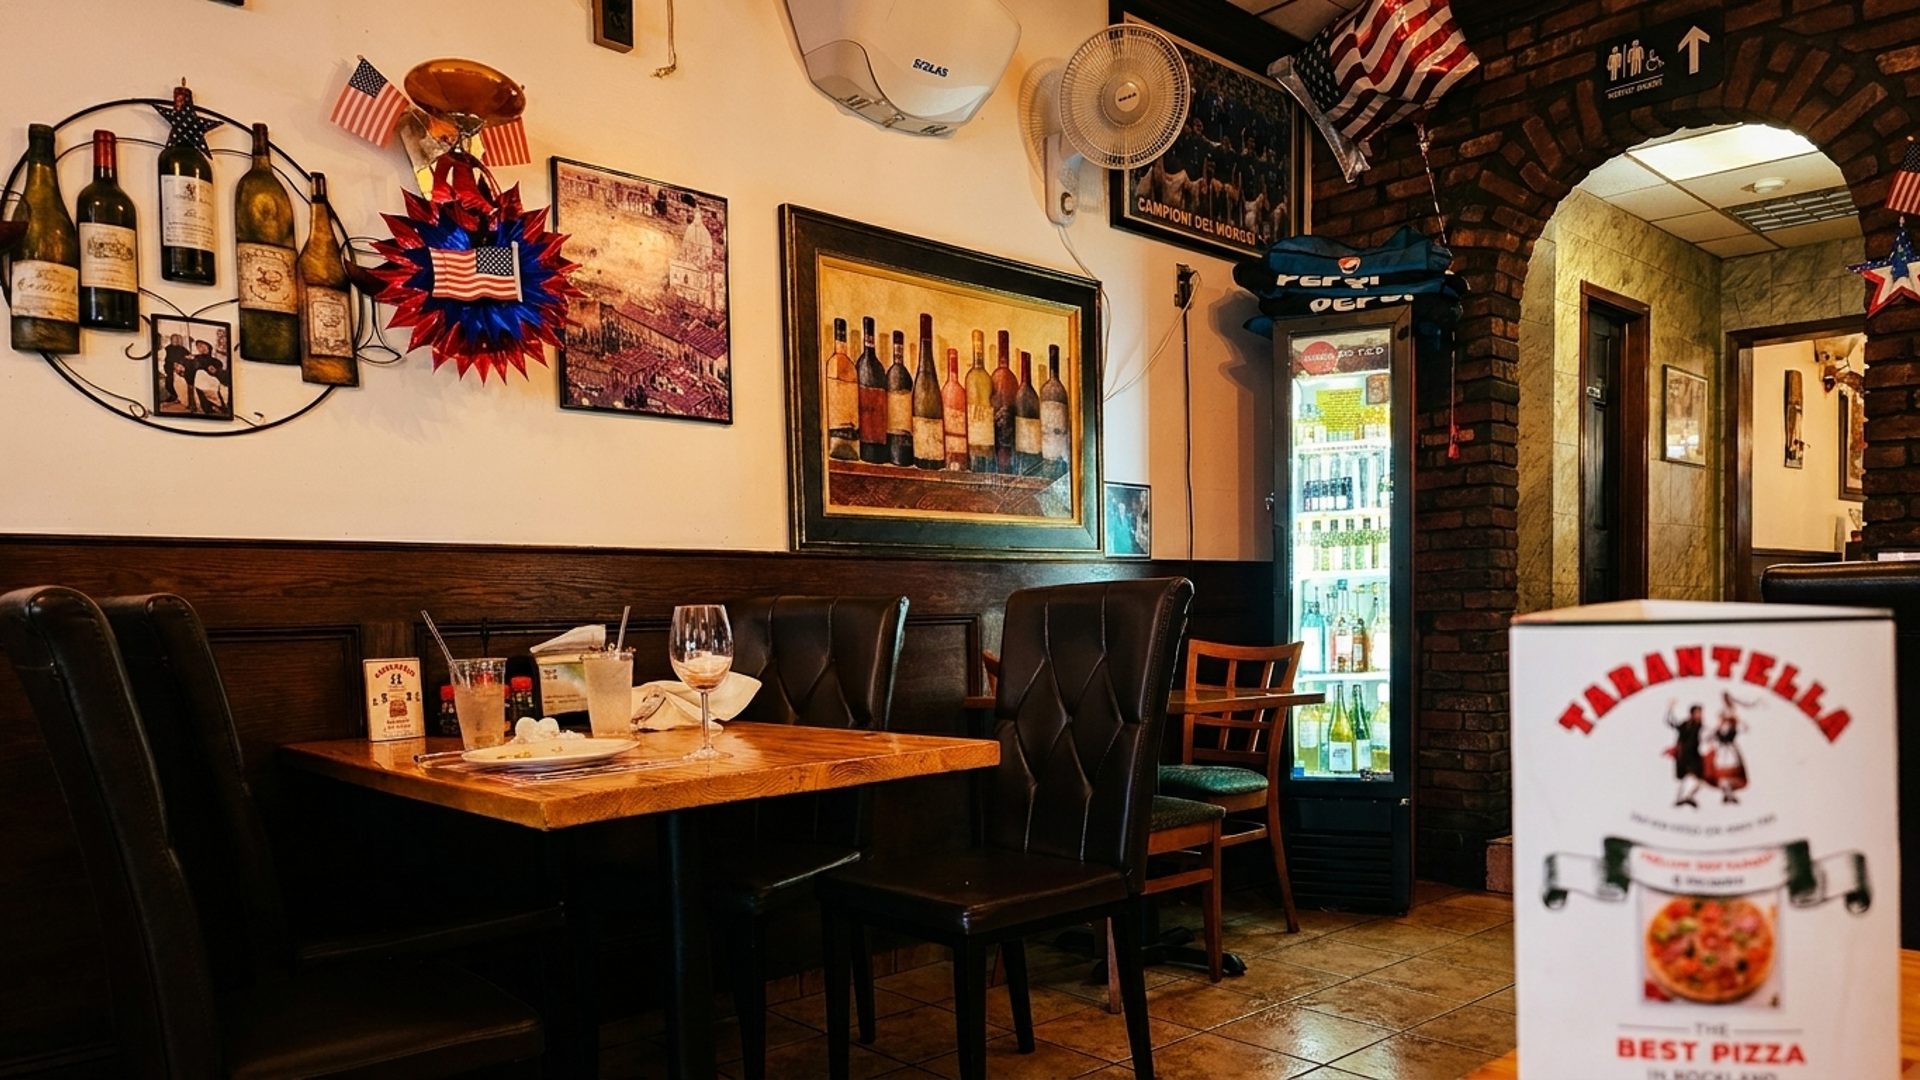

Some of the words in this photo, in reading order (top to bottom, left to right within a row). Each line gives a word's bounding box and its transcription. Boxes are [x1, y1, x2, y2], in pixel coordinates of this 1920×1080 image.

[1137, 197, 1193, 227] CAMPIONI
[1557, 645, 1852, 743] TARANTELLA
[1695, 1023, 1728, 1036] THE
[1617, 1038, 1698, 1061] BEST
[1711, 1041, 1807, 1065] PIZZA
